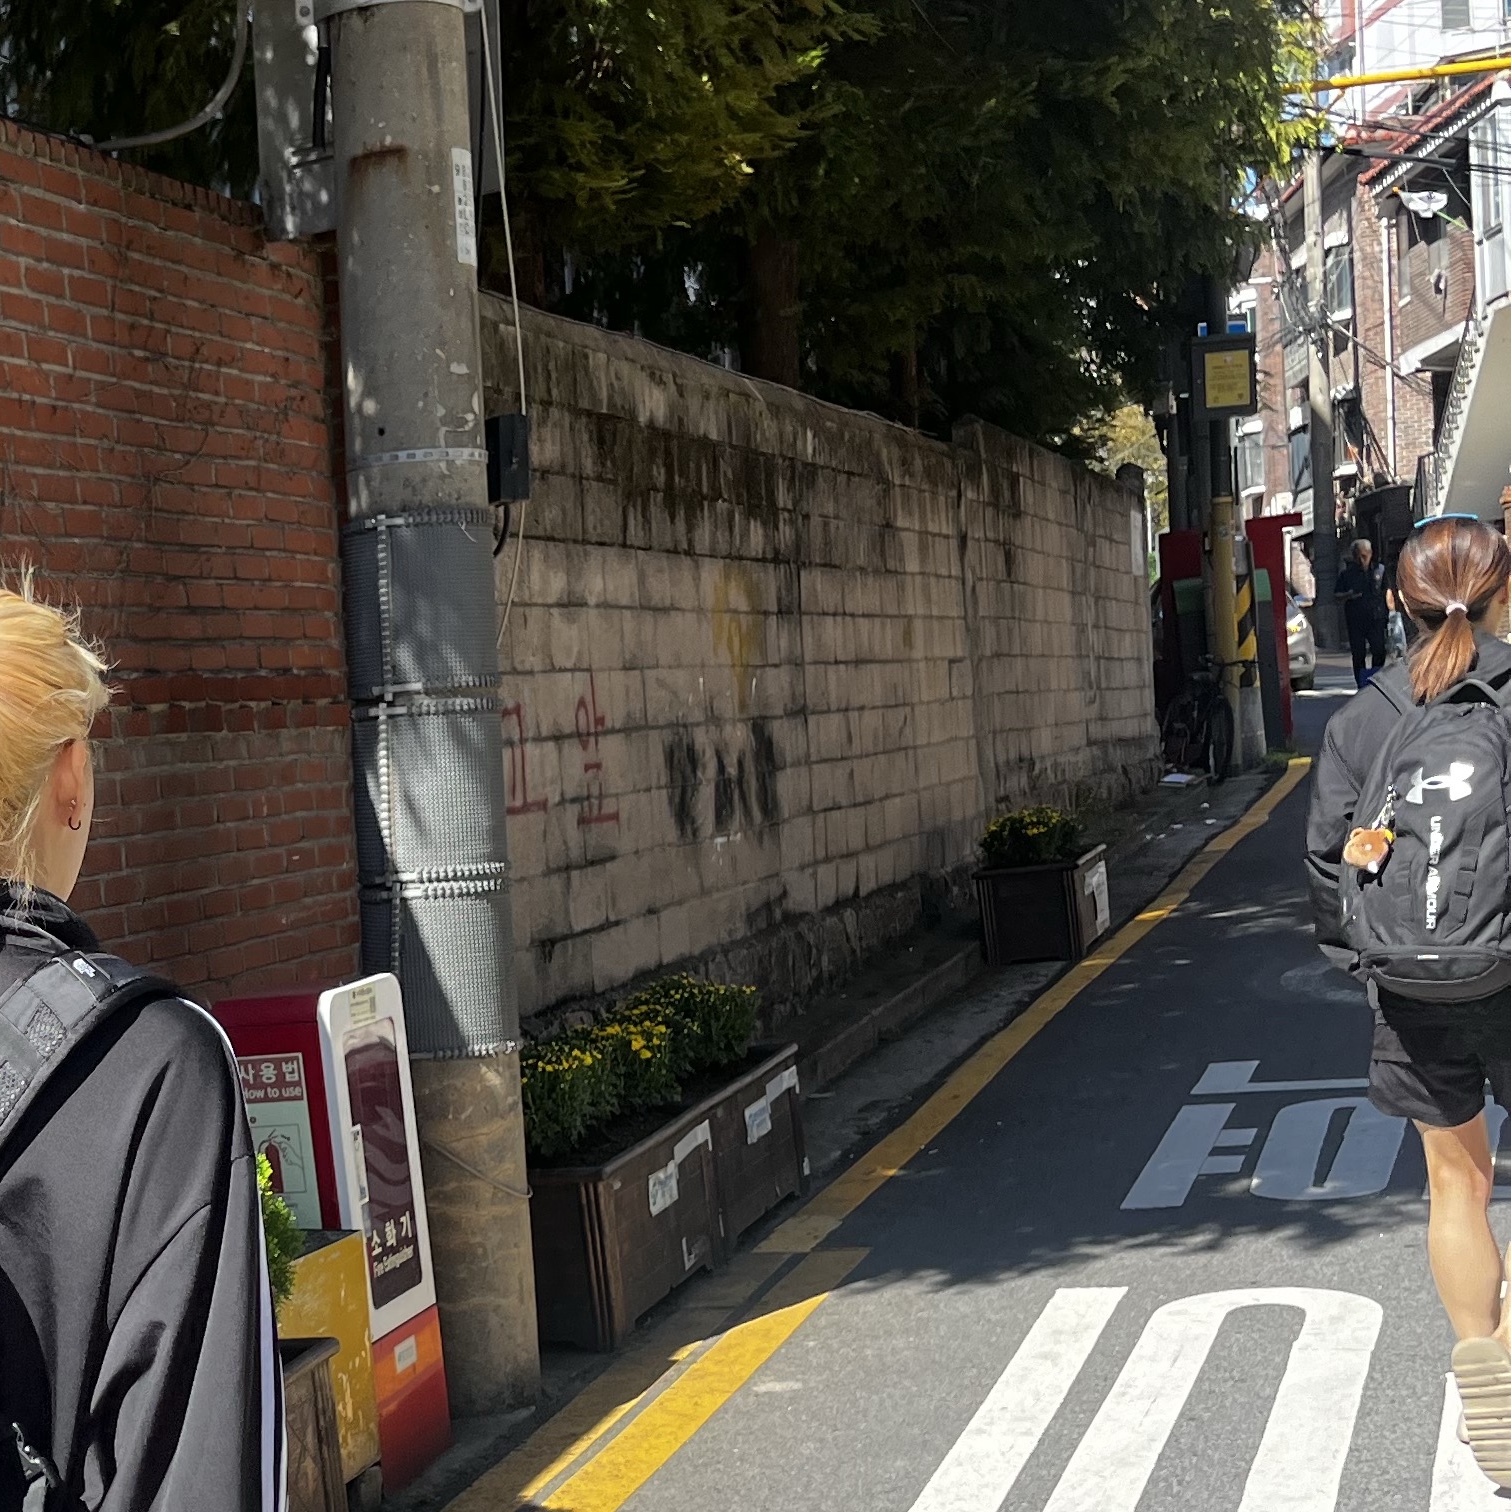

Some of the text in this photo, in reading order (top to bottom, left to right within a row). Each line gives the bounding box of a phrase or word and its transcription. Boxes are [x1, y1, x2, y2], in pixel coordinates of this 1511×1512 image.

[1425, 815, 1444, 930] UNDER ARMOUR
[240, 1060, 300, 1084] 사용법
[267, 1086, 279, 1098] to
[282, 1086, 302, 1097] use
[371, 1210, 413, 1257] 소화기
